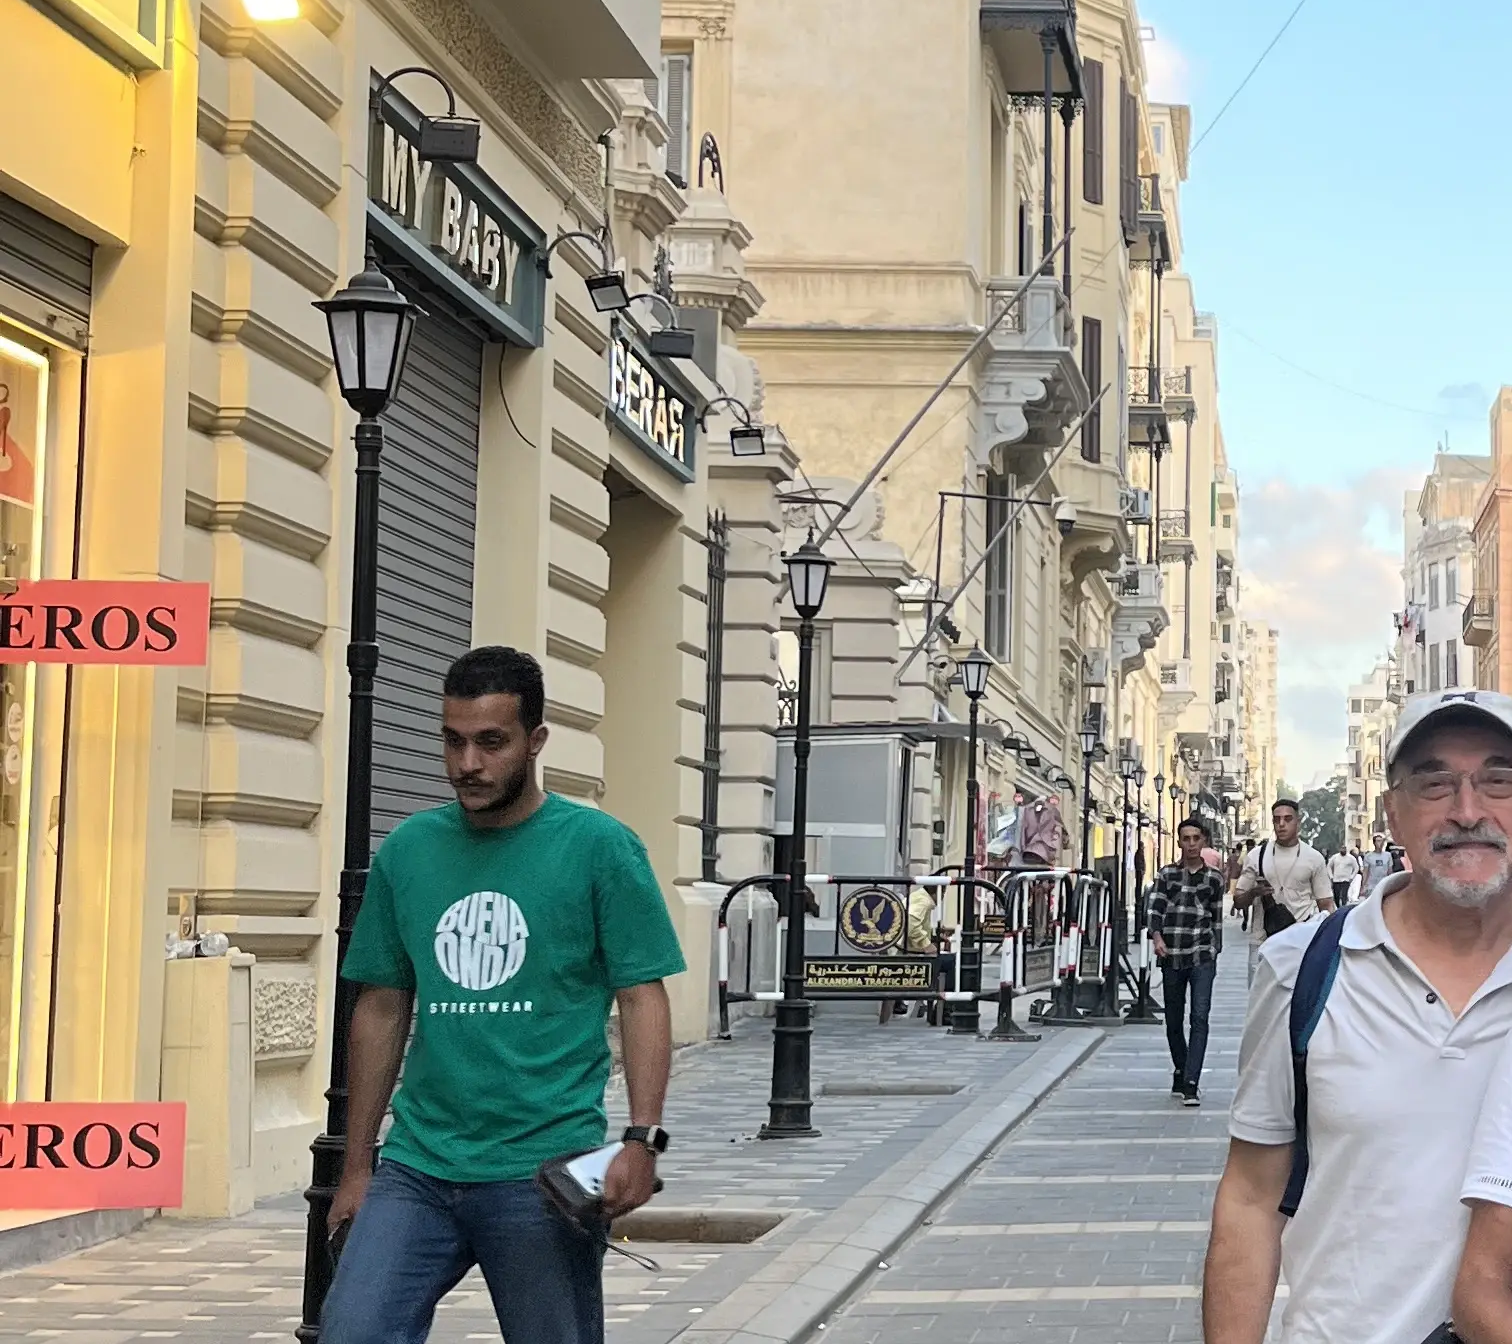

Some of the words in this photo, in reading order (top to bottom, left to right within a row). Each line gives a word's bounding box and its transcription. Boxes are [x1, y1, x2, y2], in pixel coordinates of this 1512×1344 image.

[381, 122, 433, 231] MY
[440, 176, 521, 306] BABY
[435, 891, 530, 946] BUENA
[434, 931, 527, 991] ONDA
[807, 977, 862, 986] ALEXANDRIA
[864, 977, 900, 986] TRAFFIC
[429, 1000, 533, 1014] STREETWEAR
